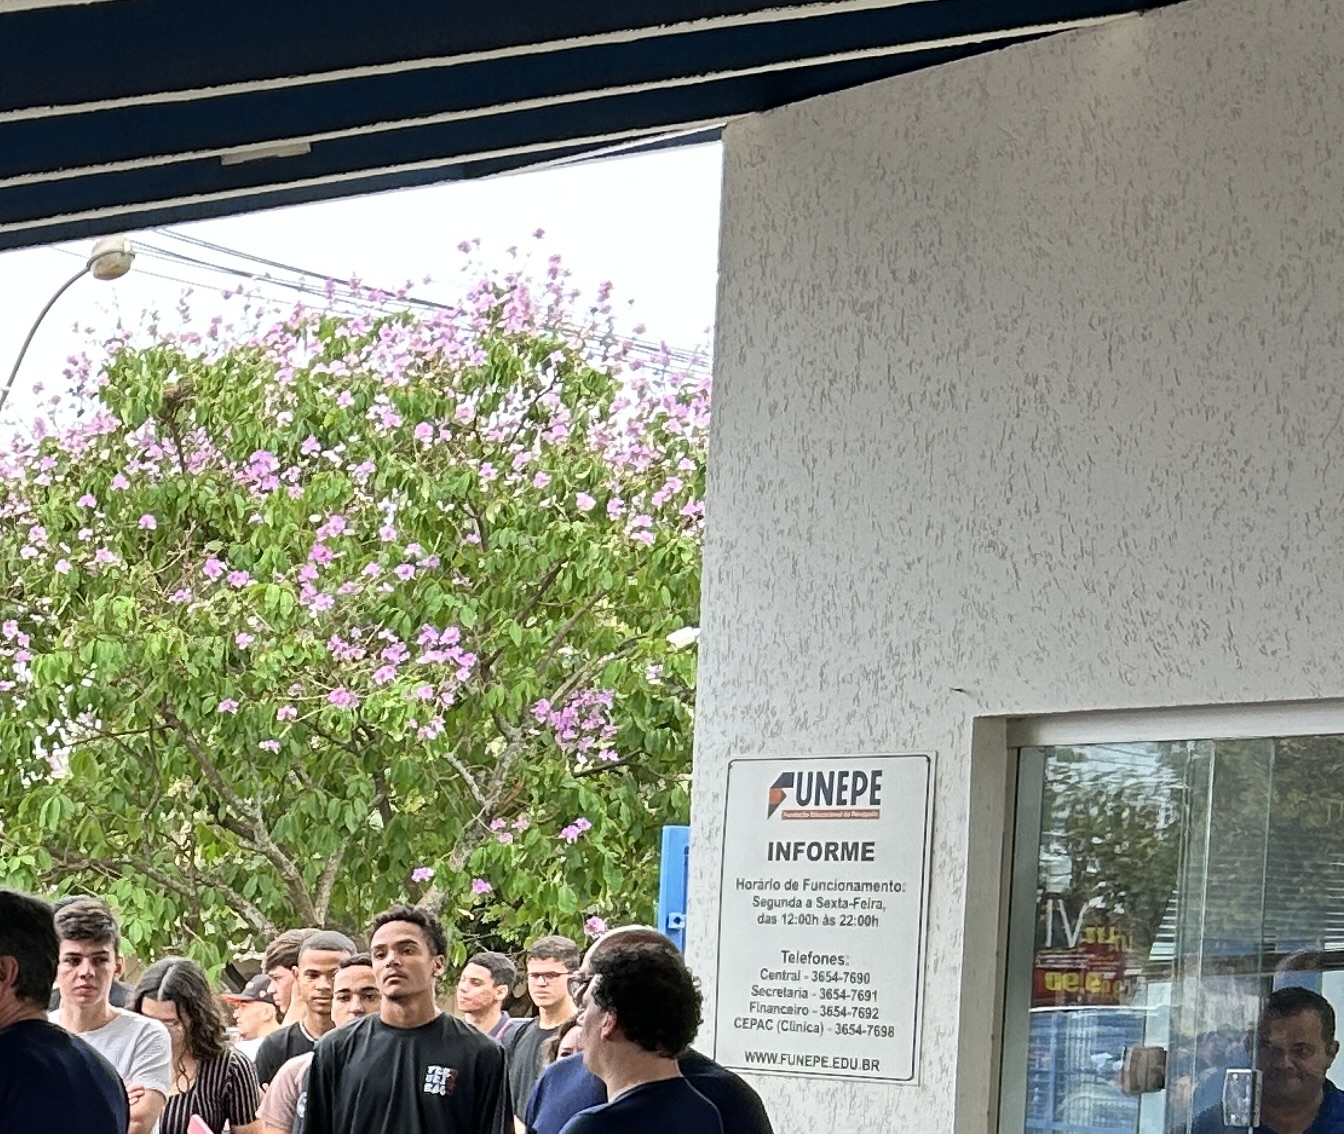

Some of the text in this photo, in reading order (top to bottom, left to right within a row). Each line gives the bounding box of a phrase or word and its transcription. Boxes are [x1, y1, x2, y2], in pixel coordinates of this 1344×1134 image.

[768, 770, 883, 819] FUNEPE
[767, 841, 875, 862] INFORME
[736, 877, 907, 893] Horário de Funcionamento:
[752, 895, 886, 912] Segunda a Sexta-Feira,
[757, 912, 777, 925] das
[782, 913, 819, 926] 12:00h
[839, 914, 879, 927] 22:00h
[781, 949, 850, 966] Telefones:
[760, 968, 801, 981] Central
[811, 970, 871, 985] 3654-7690
[750, 984, 809, 999] Secretaria
[819, 987, 878, 1002] 3654-7691
[749, 1001, 809, 1015] Financeiro
[819, 1004, 879, 1020] 3654-7692
[733, 1016, 774, 1031] CEPAC
[834, 1022, 895, 1038] 3654-7698
[744, 1050, 880, 1072] WWW.FUNEPE.EDU.BR
